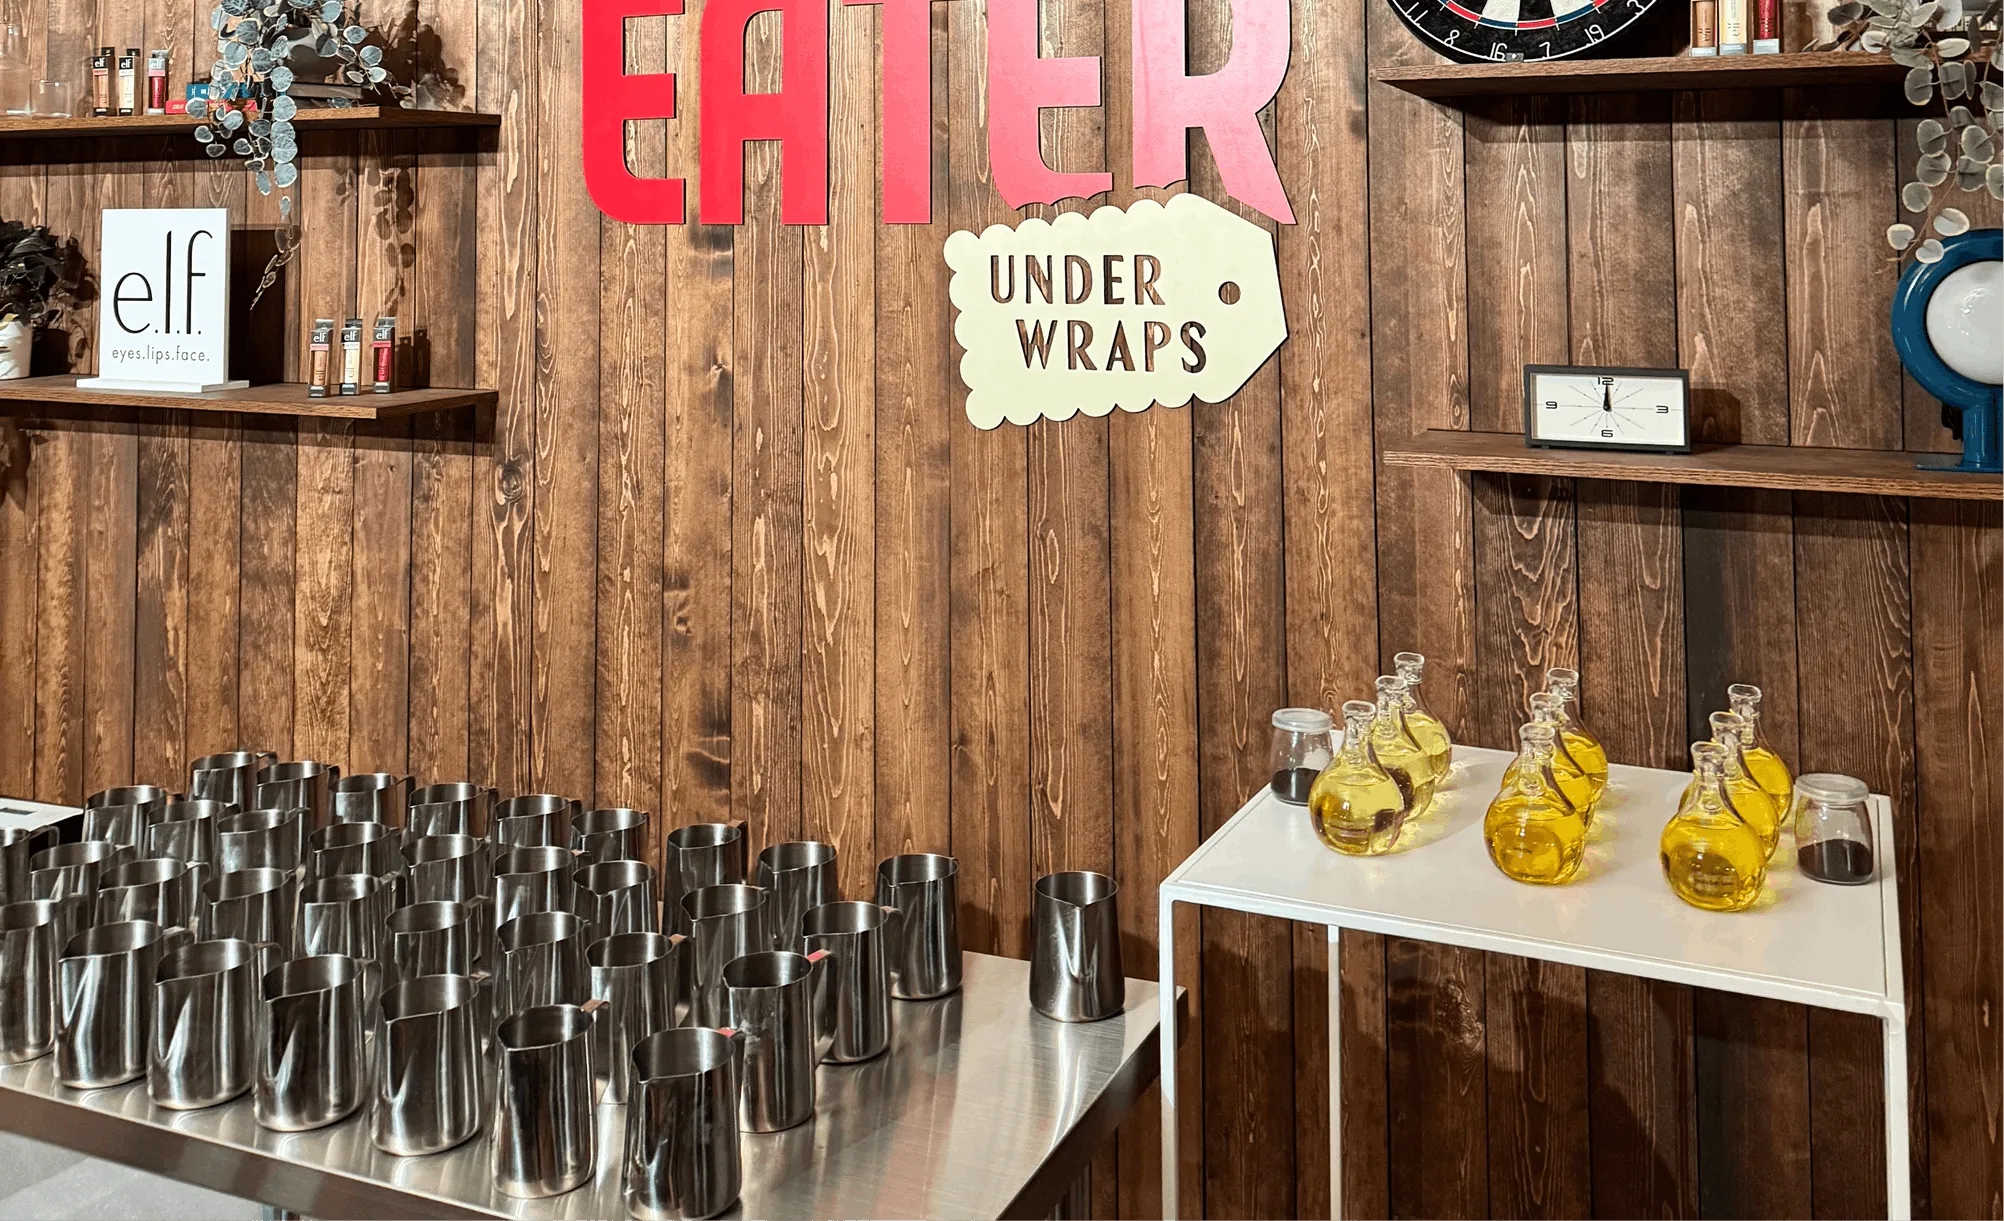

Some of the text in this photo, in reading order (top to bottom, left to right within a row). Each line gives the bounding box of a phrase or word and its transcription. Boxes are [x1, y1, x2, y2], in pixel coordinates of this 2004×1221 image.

[1405, 2, 1429, 26] 11
[1444, 29, 1460, 47] 8
[1584, 24, 1605, 46] 19
[1486, 42, 1508, 61] 16
[1539, 41, 1550, 60] 7
[94, 57, 106, 68] elf
[120, 58, 132, 69] elf
[149, 57, 163, 69] elf
[582, 0, 1297, 225] EATER
[113, 230, 213, 335] e.l.f.
[991, 254, 1166, 306] UNDER
[313, 332, 327, 343] elf
[344, 330, 357, 341] elf
[376, 328, 389, 340] elf
[1015, 319, 1207, 374] WRAPS
[1597, 376, 1614, 386] 12
[1545, 400, 1558, 410] 9
[1656, 405, 1669, 414] 3
[1601, 429, 1614, 438] 6
